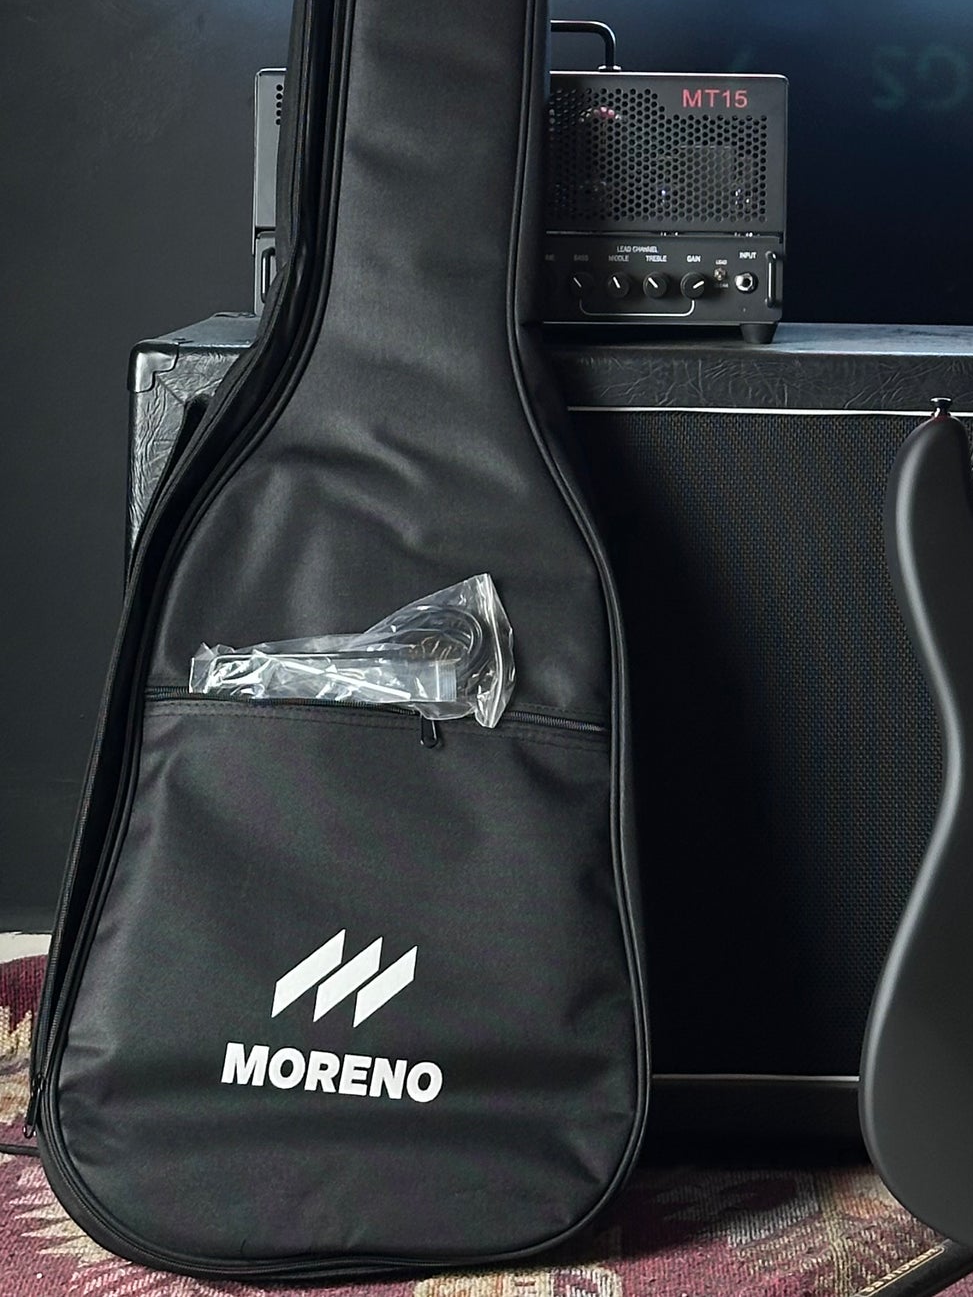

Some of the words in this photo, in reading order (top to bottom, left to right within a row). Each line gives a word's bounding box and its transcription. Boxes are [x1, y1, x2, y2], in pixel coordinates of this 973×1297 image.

[682, 89, 748, 108] MT15
[617, 245, 632, 253] LEAD
[645, 255, 667, 263] TREBLE
[687, 255, 701, 263] GAIN
[220, 1042, 443, 1103] MORENO
